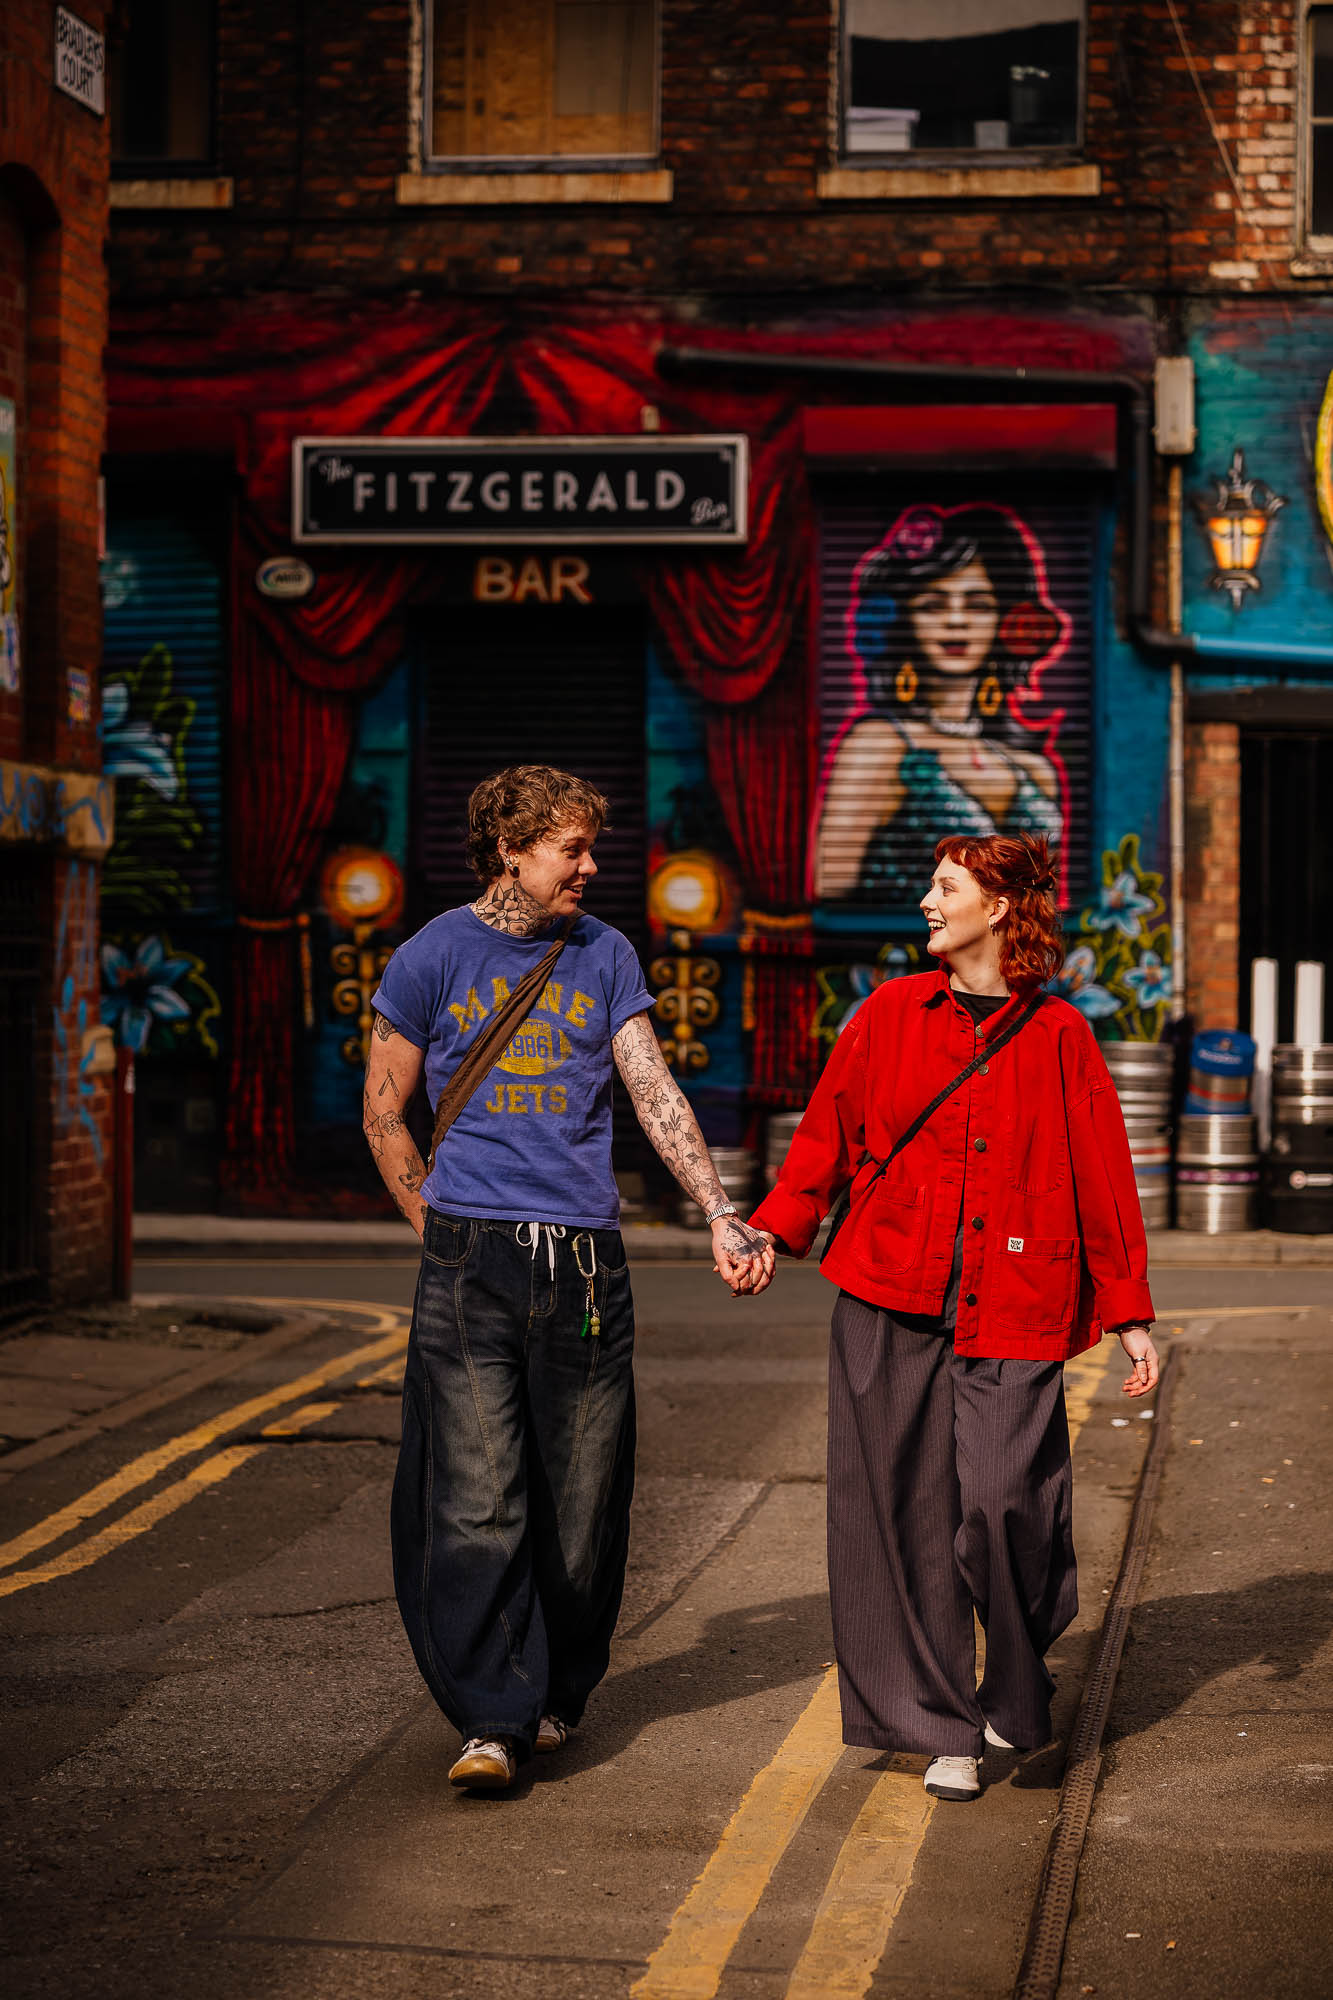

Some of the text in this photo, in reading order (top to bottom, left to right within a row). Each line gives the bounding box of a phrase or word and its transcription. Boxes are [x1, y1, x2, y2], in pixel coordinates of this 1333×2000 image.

[62, 54, 94, 98] COURT
[354, 471, 685, 512] FITZGERALD
[475, 556, 592, 604] BAR
[448, 976, 596, 1032] MANE
[485, 1084, 568, 1114] JETS
